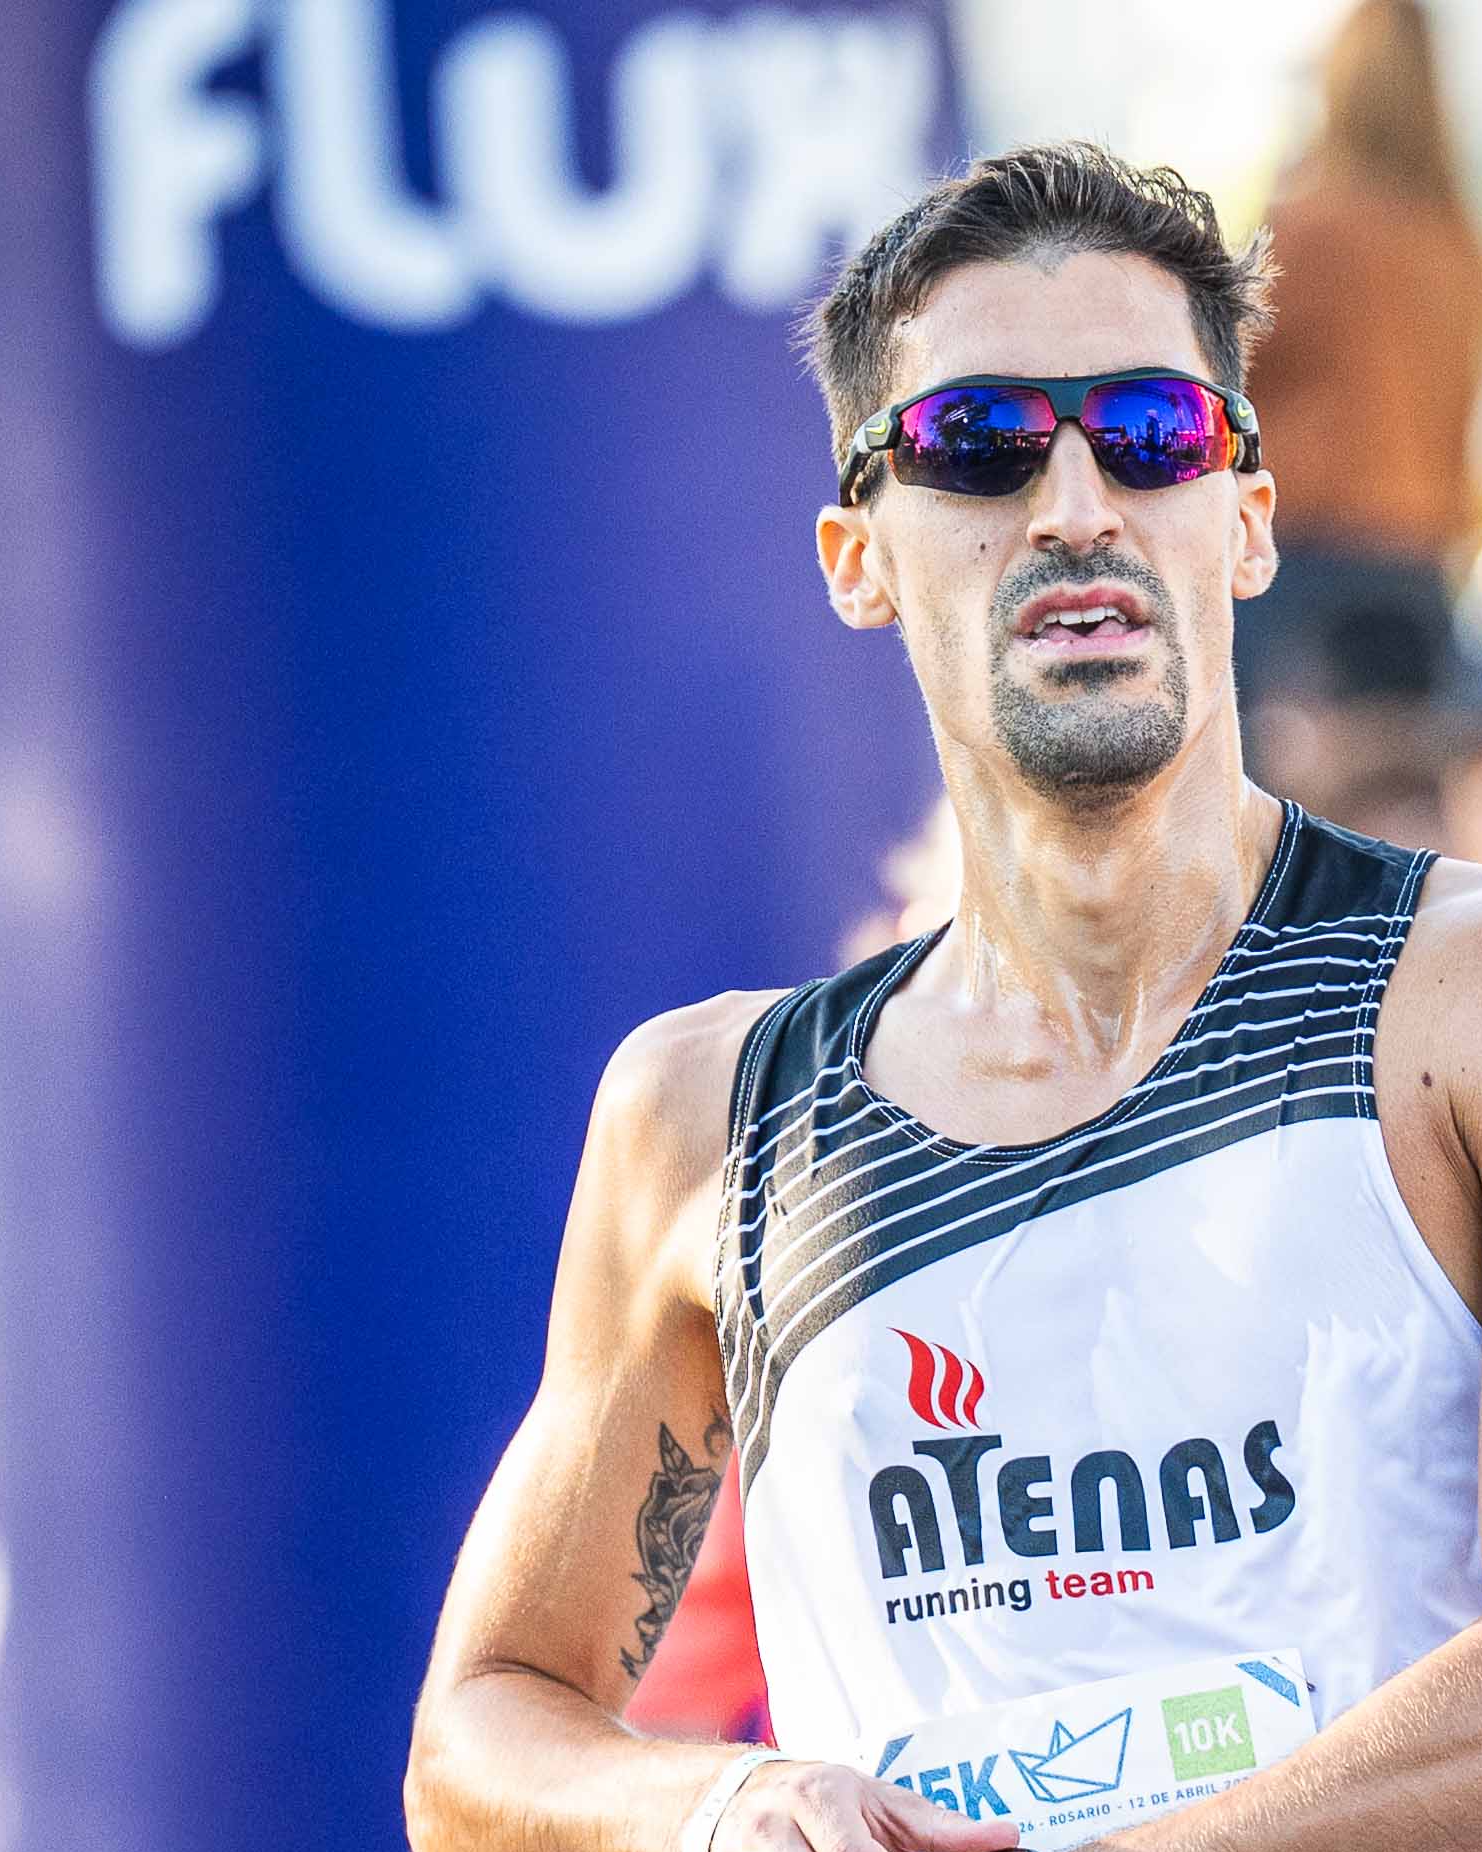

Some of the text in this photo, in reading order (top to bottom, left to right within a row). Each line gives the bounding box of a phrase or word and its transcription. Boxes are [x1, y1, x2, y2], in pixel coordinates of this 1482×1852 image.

[869, 1420, 1296, 1579] ATENAS
[886, 1569, 1154, 1624] running team
[1173, 1714, 1244, 1754] 10K
[894, 1754, 1011, 1820] 5K
[1049, 1804, 1111, 1827] ROSARIO
[1129, 1799, 1145, 1811] 12
[1151, 1792, 1169, 1806] DE
[1176, 1783, 1219, 1800] ABRIL
